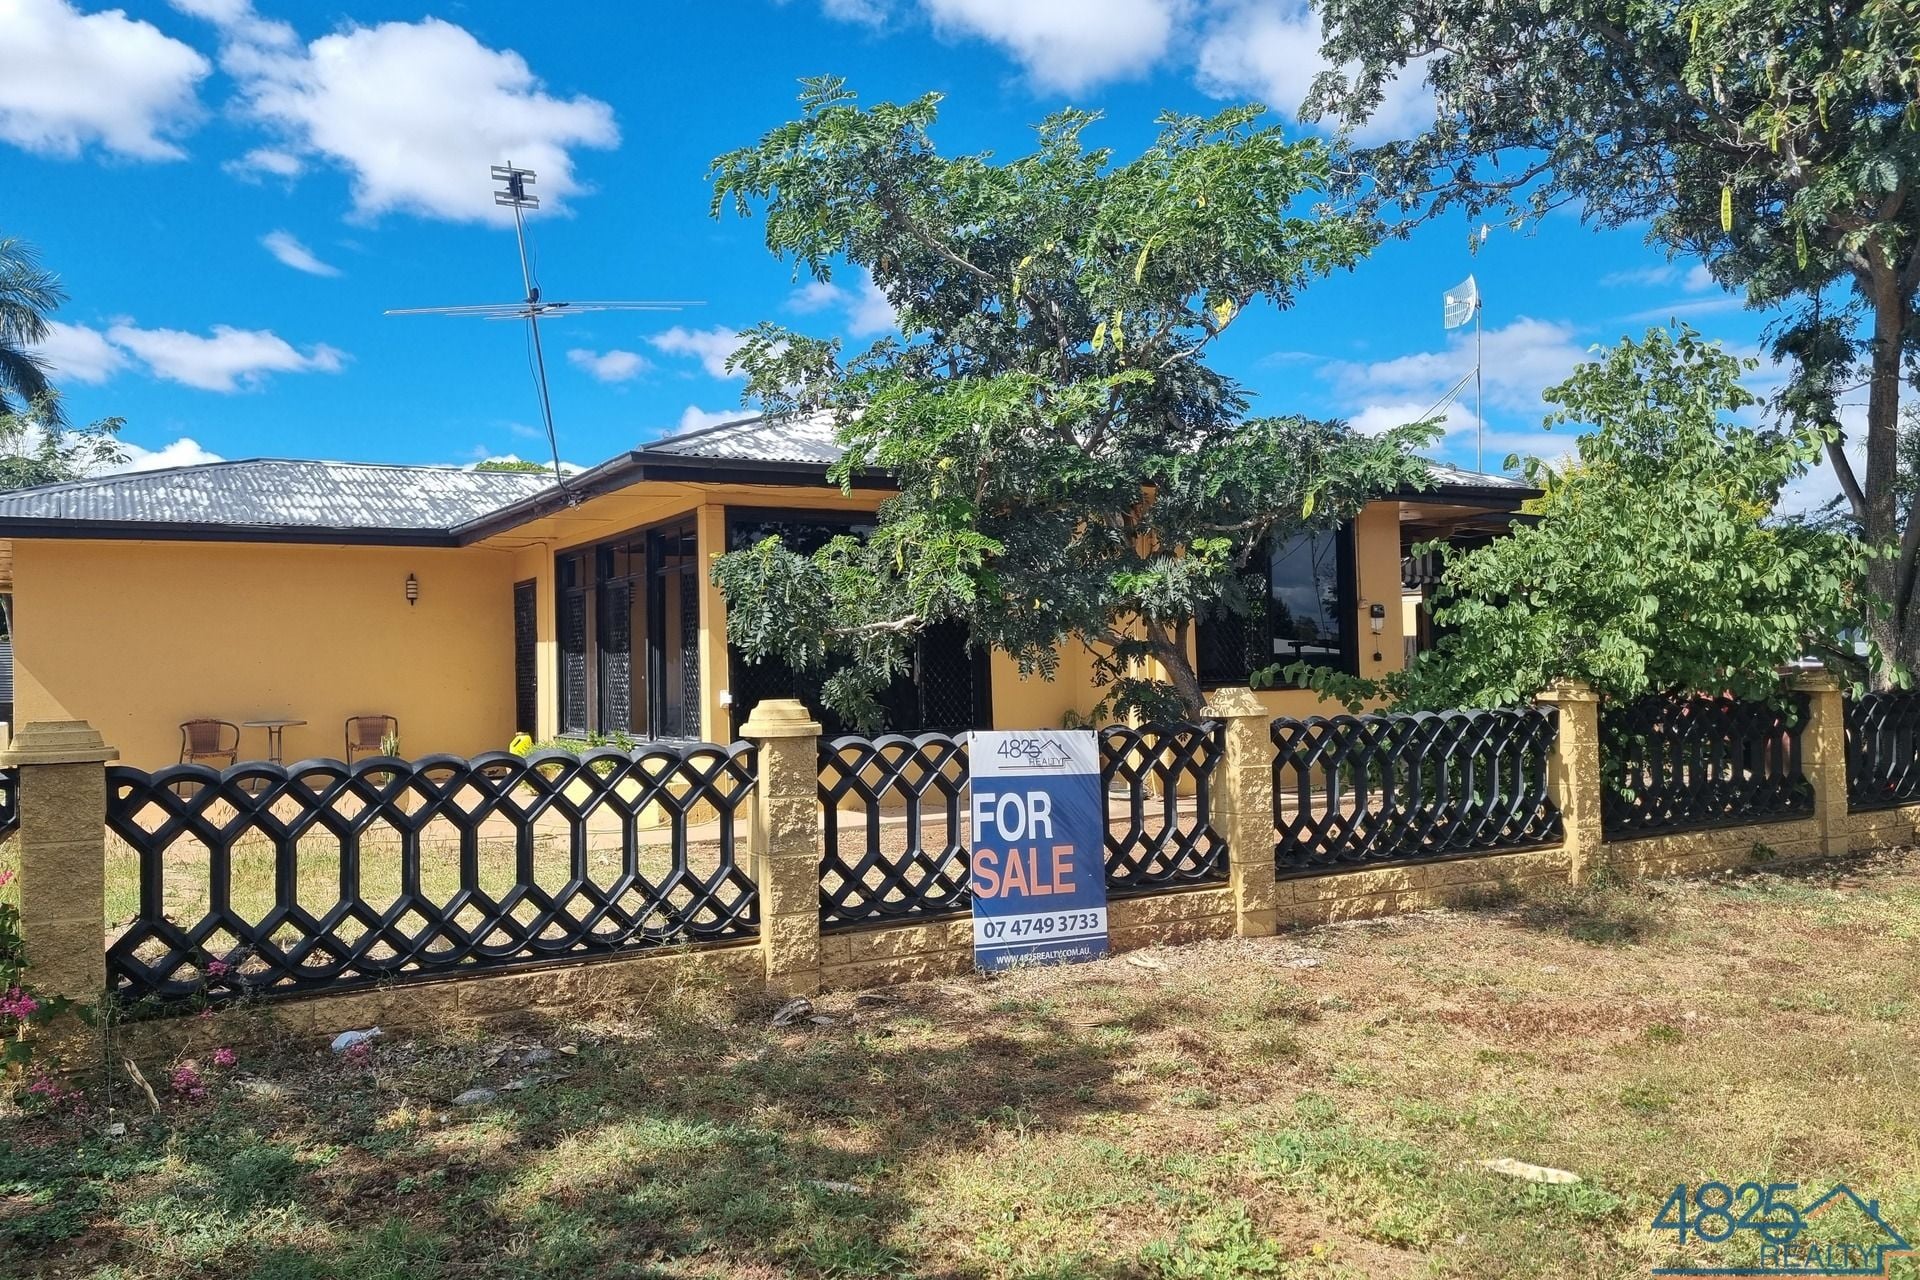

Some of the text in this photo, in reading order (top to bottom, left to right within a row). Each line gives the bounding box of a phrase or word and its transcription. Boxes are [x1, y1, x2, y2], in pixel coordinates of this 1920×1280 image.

[997, 739, 1042, 759] 4825
[1028, 757, 1062, 767] REALTY
[973, 791, 1053, 842] FOR
[972, 845, 1076, 898] SALE
[983, 913, 1099, 938] 07 4749 3733
[996, 947, 1090, 964] WWW.4825REALTY.COM.AU
